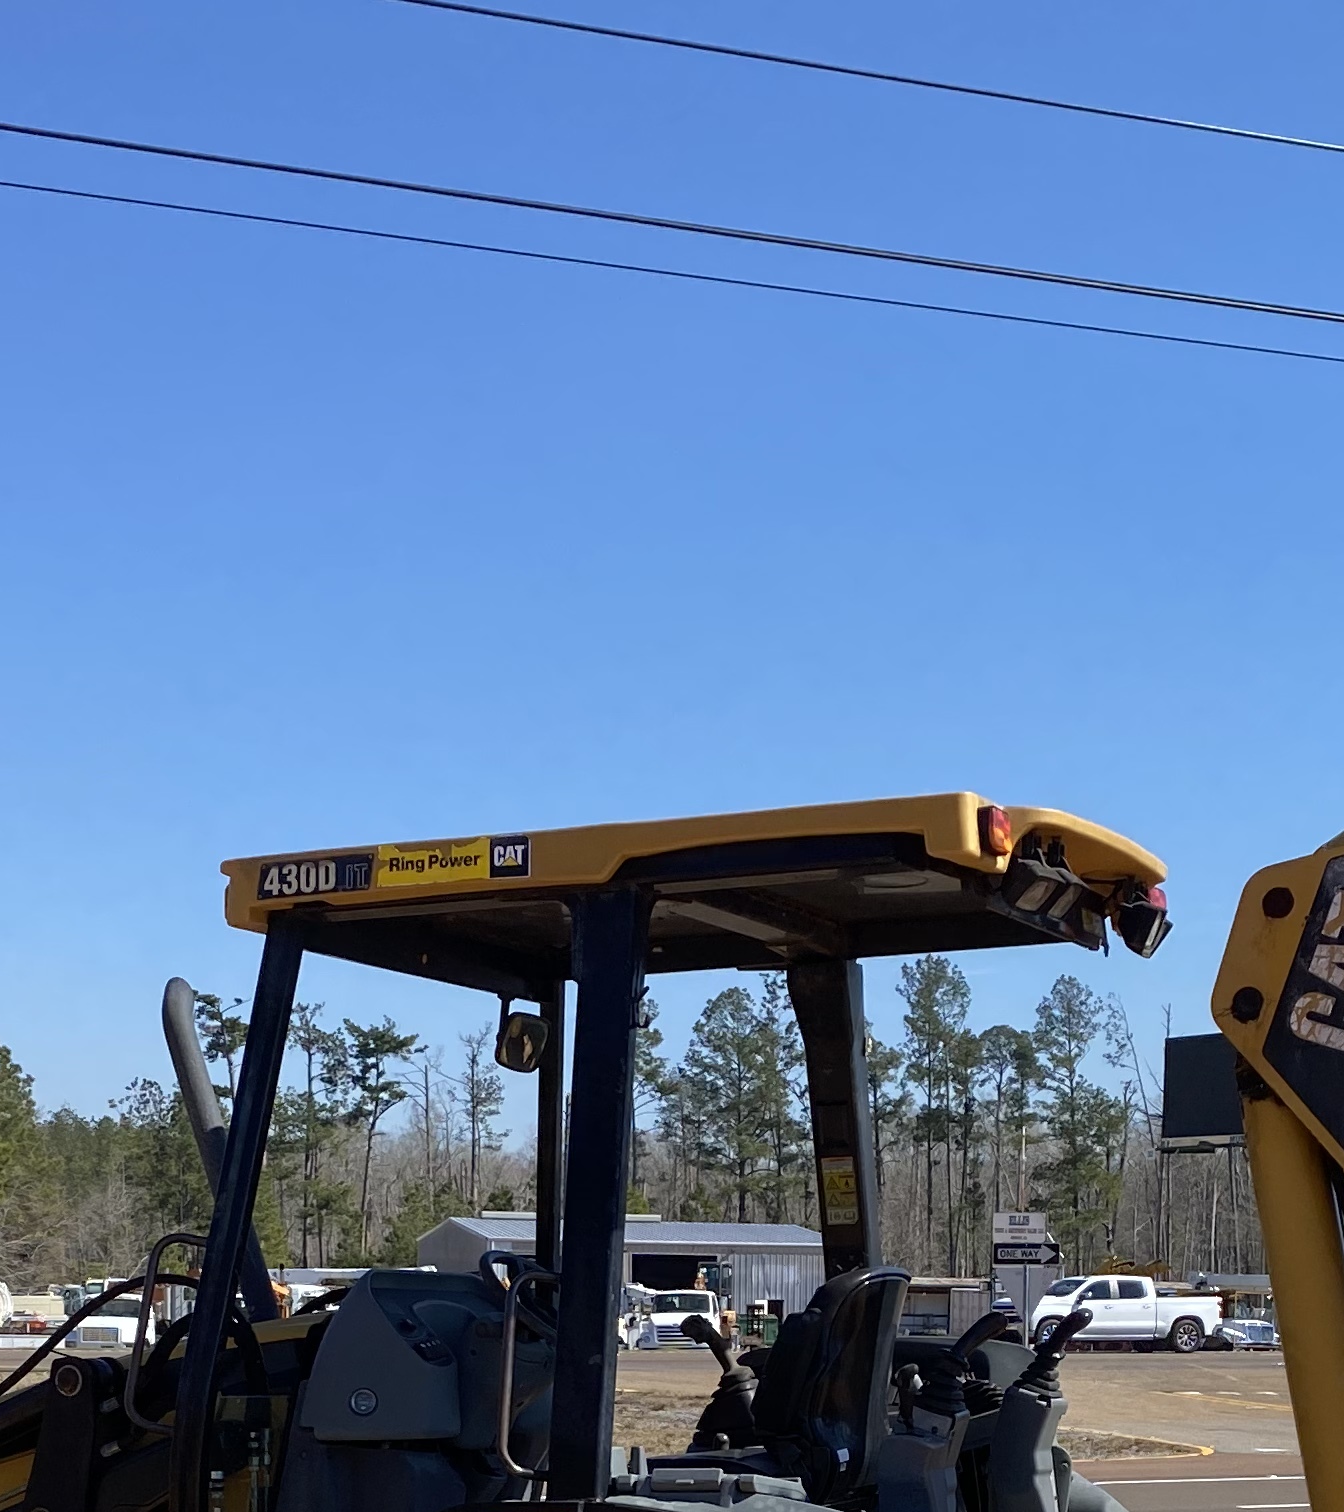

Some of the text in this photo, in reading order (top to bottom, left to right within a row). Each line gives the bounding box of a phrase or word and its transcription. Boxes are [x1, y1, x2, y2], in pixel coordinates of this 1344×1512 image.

[388, 853, 481, 873] Ring Power
[493, 844, 527, 868] CAT
[263, 860, 369, 896] 430D IT
[999, 1249, 1040, 1258] ONE WAY
